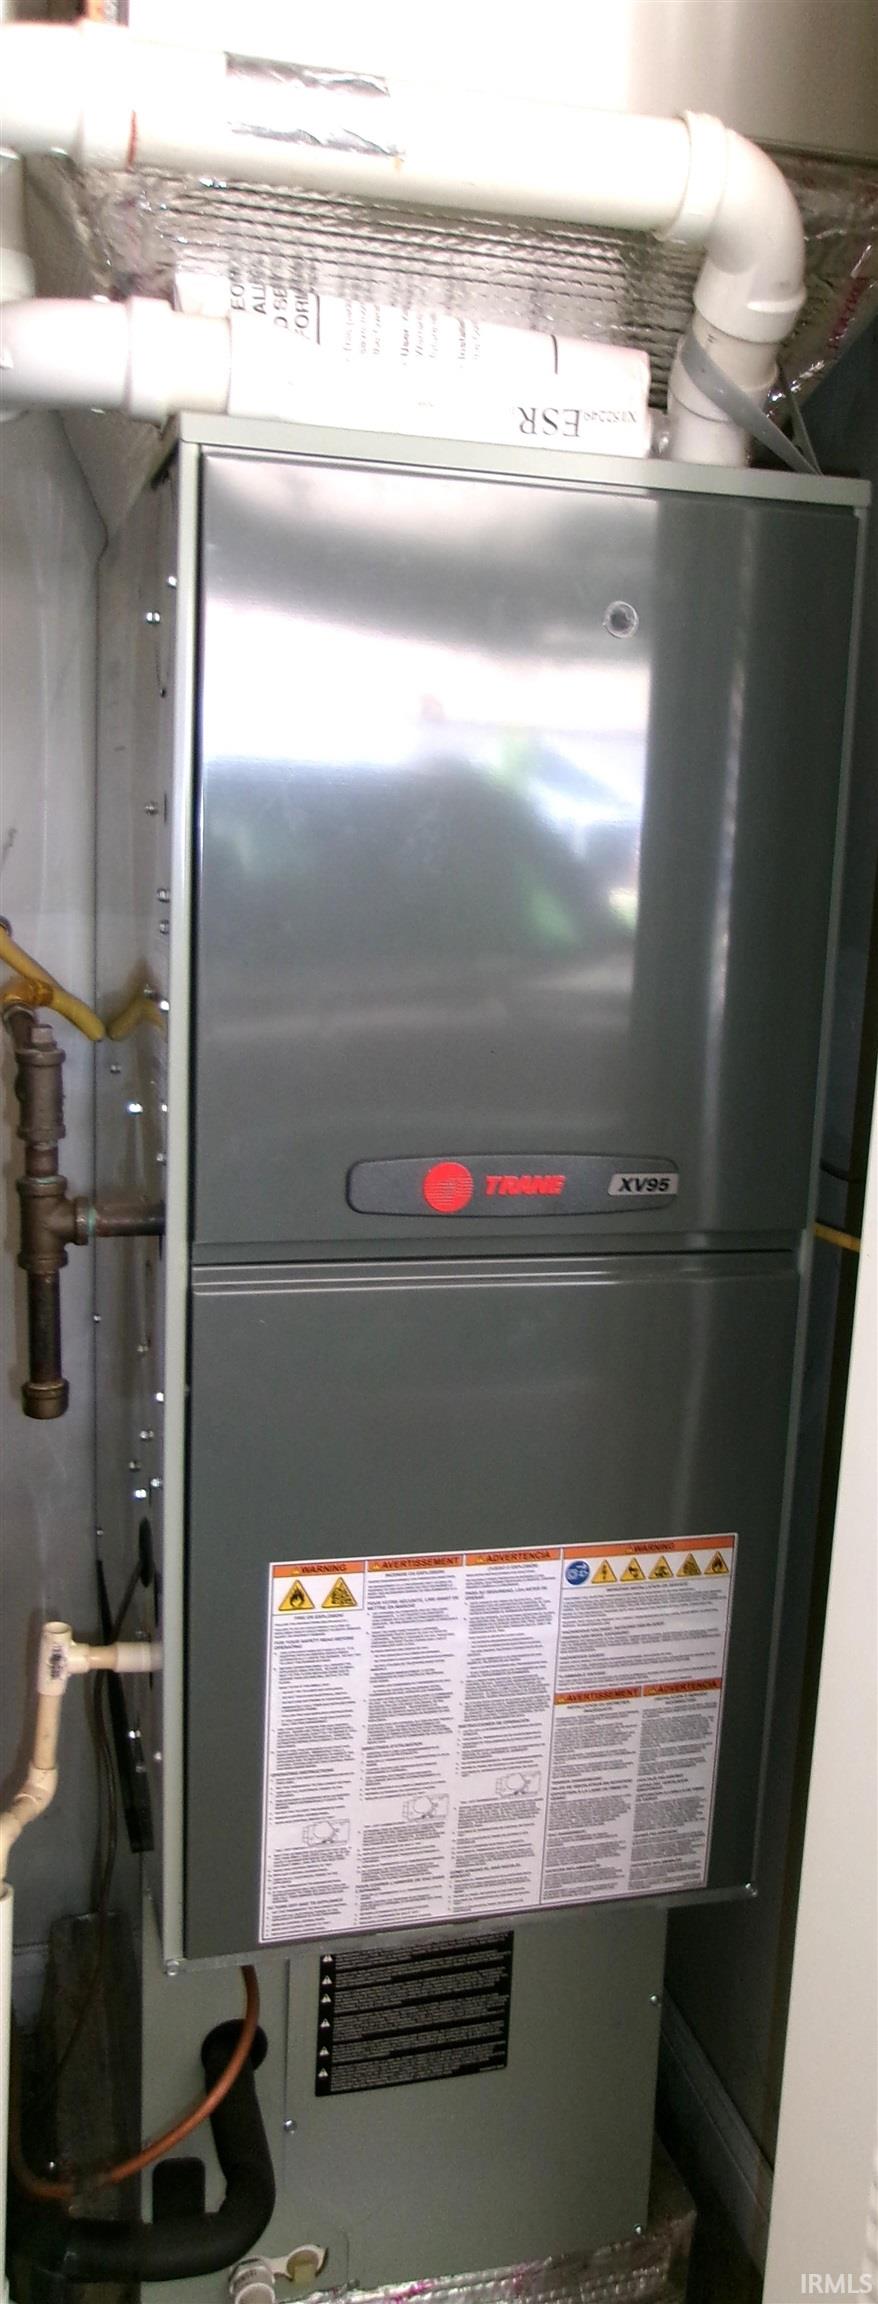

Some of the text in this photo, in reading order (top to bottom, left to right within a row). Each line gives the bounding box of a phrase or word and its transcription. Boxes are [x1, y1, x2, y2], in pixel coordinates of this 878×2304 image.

[517, 406, 581, 437] ESR
[485, 1174, 671, 1196] TRANE XV95
[301, 1551, 551, 1574] WARNING AVERTISSEMENT ADVERTENCIA
